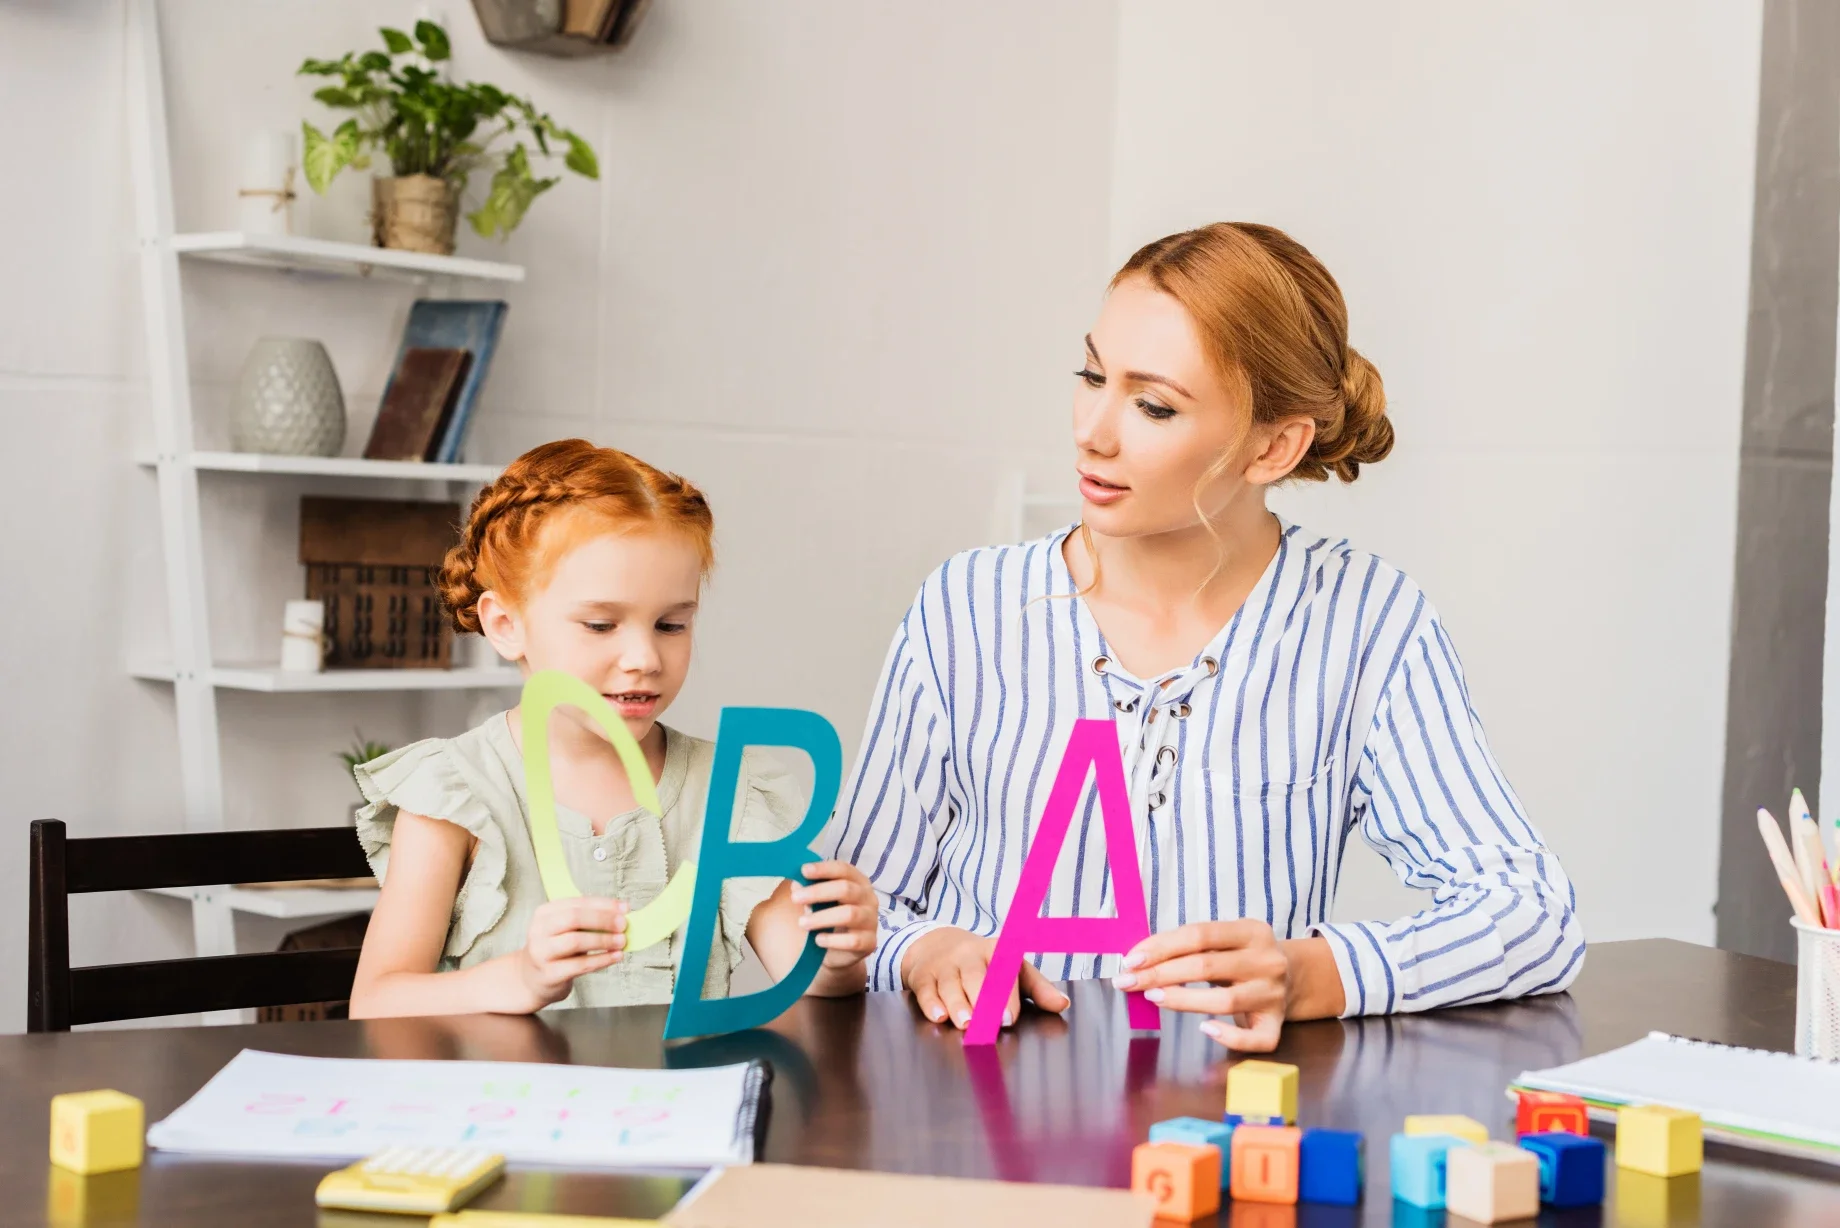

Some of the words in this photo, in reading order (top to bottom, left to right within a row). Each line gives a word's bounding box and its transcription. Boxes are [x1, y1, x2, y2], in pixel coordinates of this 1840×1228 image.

[521, 669, 697, 952] C
[664, 706, 843, 1040] B
[963, 718, 1160, 1046] A
[1146, 1168, 1174, 1203] G
